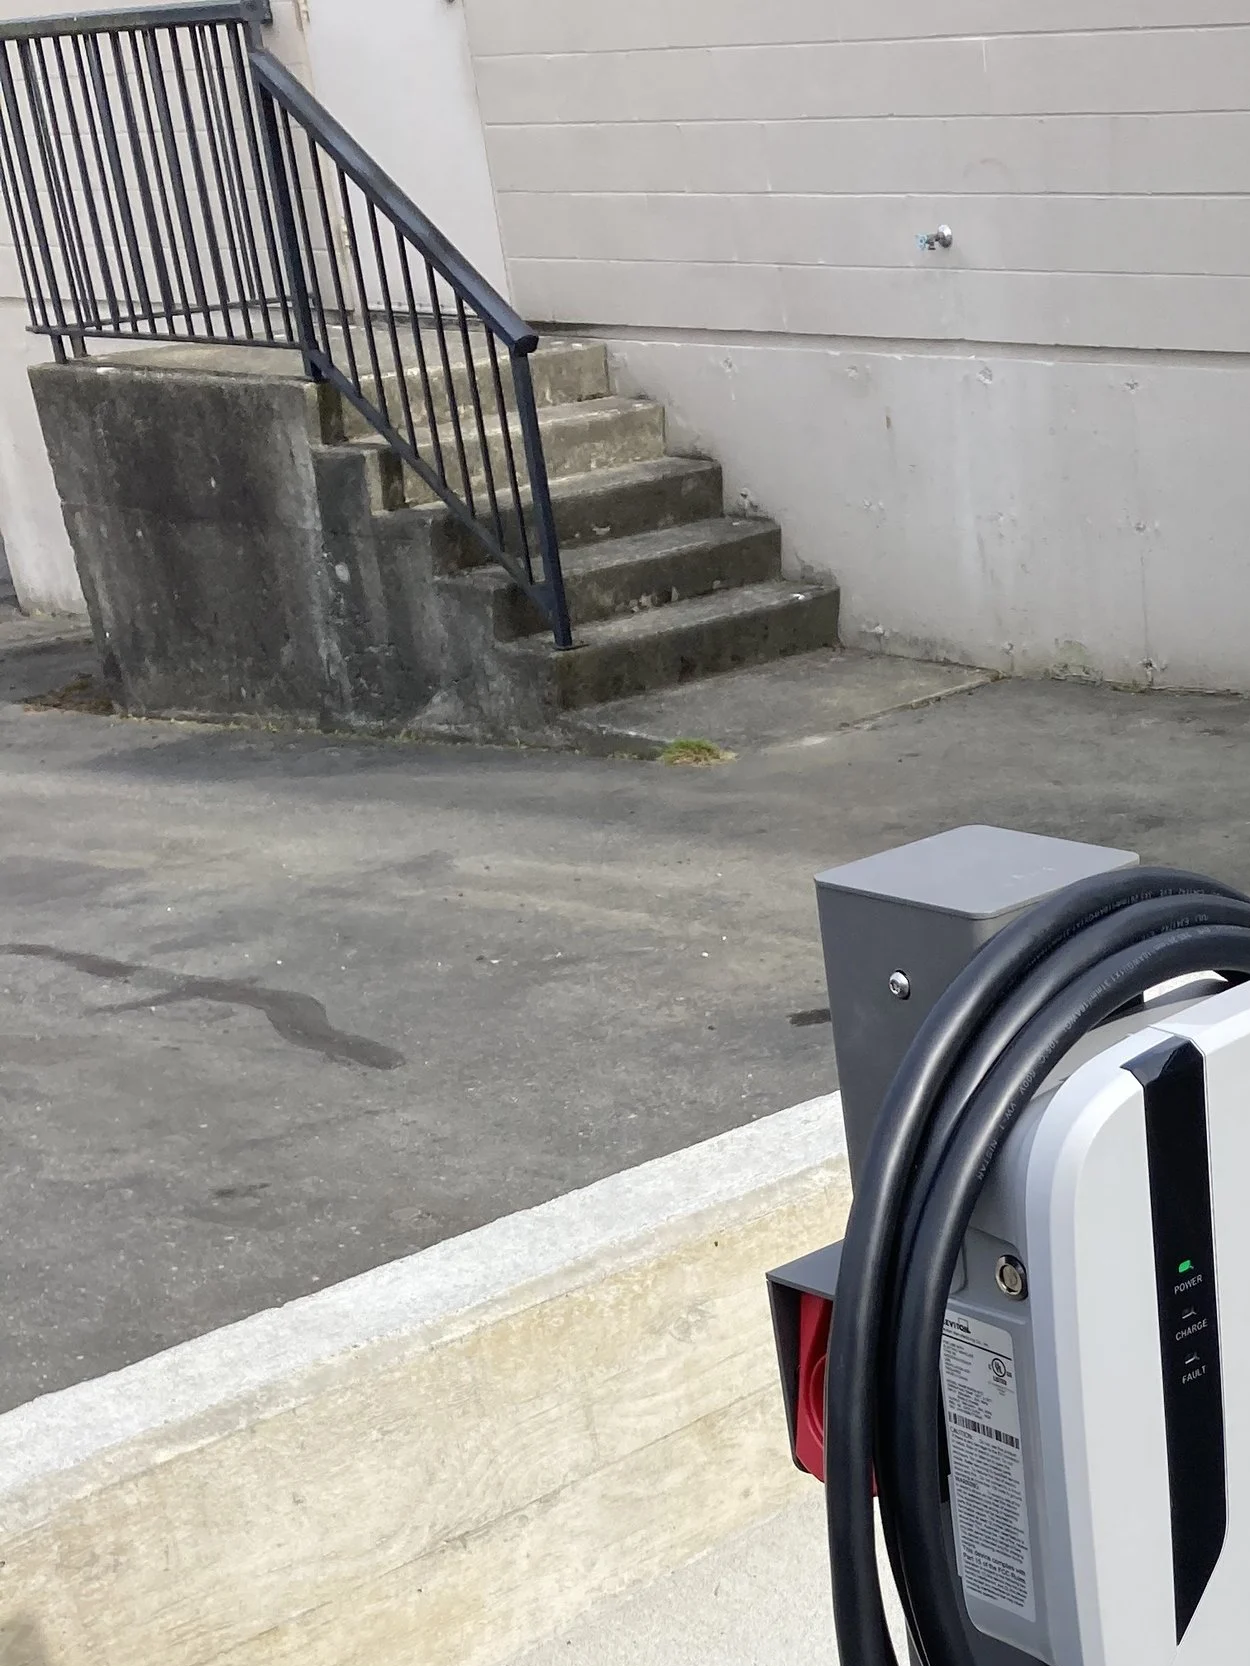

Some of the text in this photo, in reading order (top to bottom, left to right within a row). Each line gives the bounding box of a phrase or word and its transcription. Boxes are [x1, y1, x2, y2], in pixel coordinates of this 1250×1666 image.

[1174, 1274, 1203, 1295] POWER
[1175, 1318, 1208, 1341] CHARGE
[1182, 1365, 1206, 1384] FAULT
